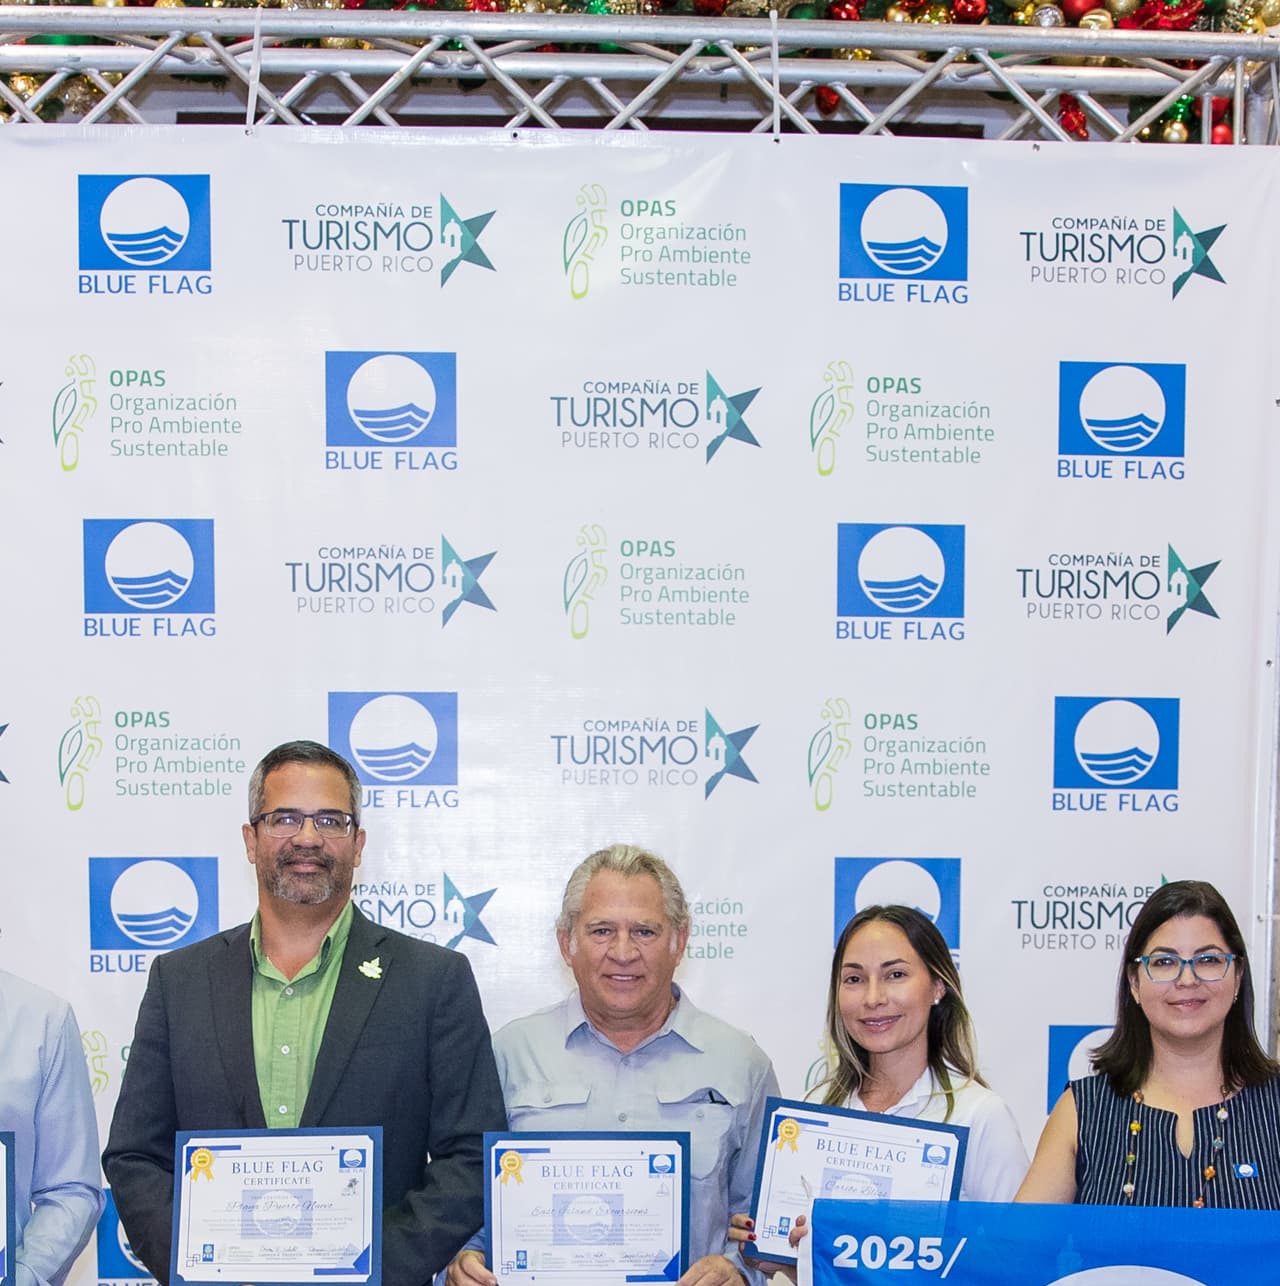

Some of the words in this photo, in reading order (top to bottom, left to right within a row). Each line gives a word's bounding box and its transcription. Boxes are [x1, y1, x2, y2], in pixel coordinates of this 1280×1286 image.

[315, 203, 405, 218] COMPAÑÍA
[411, 206, 432, 218] DE
[620, 199, 676, 217] OPAS
[1052, 216, 1139, 231] COMPAÑÍA
[1145, 219, 1166, 231] DE
[281, 219, 433, 252] TURISMO
[621, 222, 746, 245] Organización
[621, 245, 653, 262] Pro
[658, 245, 751, 264] Ambiente
[1019, 232, 1166, 264] TURISMO
[294, 254, 372, 271] PUERTO
[382, 255, 434, 273] RICO
[78, 275, 136, 294] BLUE
[149, 275, 212, 294] FLAG
[620, 268, 737, 287] Sustentable
[1031, 266, 1107, 283] PUERTO
[1116, 268, 1166, 285] RICO
[839, 283, 895, 302] BLUE
[907, 284, 968, 304] FLAG
[109, 370, 166, 387] OPAS
[583, 379, 671, 394] COMPAÑÍA
[677, 382, 699, 395] DE
[867, 376, 921, 394] OPAS
[110, 393, 237, 416] Organización
[550, 396, 699, 428] TURISMO
[866, 399, 990, 422] Organización
[111, 416, 143, 434] Pro
[149, 416, 242, 434] Ambiente
[867, 422, 898, 440] Pro
[903, 423, 995, 442] Ambiente
[110, 439, 228, 457] Sustentable
[562, 431, 639, 448] PUERTO
[649, 432, 699, 449] RICO
[325, 451, 382, 470] BLUE
[395, 451, 457, 470] FLAG
[866, 444, 981, 464] Sustentable
[1058, 459, 1112, 478] BLUE
[1125, 461, 1184, 480] FLAG
[318, 544, 407, 559] COMPAÑÍA
[413, 547, 434, 560] DE
[620, 540, 676, 558] OPAS
[1048, 552, 1134, 567] COMPAÑÍA
[1140, 555, 1160, 568] DE
[285, 562, 435, 593] TURISMO
[620, 562, 745, 585] Organización
[1016, 568, 1160, 600] TURISMO
[620, 585, 652, 603] Pro
[657, 585, 750, 604] Ambiente
[297, 597, 375, 613] PUERTO
[384, 597, 435, 614] RICO
[1027, 602, 1102, 619] PUERTO
[1112, 604, 1160, 620] RICO
[620, 607, 736, 626] Sustentable
[84, 618, 141, 637] BLUE
[153, 618, 216, 636] FLAG
[836, 621, 892, 640] BLUE
[904, 621, 964, 640] FLAG
[114, 711, 170, 728] OPAS
[583, 717, 671, 732] COMPAÑÍA
[677, 720, 698, 733] DE
[864, 713, 918, 730] OPAS
[115, 733, 241, 756] Organización
[550, 735, 698, 765] TURISMO
[863, 735, 986, 758] Organización
[116, 756, 148, 774] Pro
[153, 756, 246, 773] Ambiente
[864, 758, 895, 775] Pro
[900, 758, 991, 776] Ambiente
[115, 778, 232, 796] Sustentable
[562, 769, 639, 785] PUERTO
[648, 769, 698, 786] RICO
[397, 789, 459, 808] FLAG
[863, 780, 976, 798] Sustentable
[1053, 793, 1107, 811] BLUE
[1119, 793, 1178, 812] FLAG
[415, 884, 436, 896] DE
[1043, 883, 1128, 898] COMPAÑÍA
[1133, 886, 1154, 898] DE
[1022, 933, 1096, 950] PUERTO
[90, 954, 146, 973] BLUE
[816, 1138, 858, 1156] BLUE
[865, 1146, 907, 1163] FLAG
[232, 1161, 274, 1174] BLUE
[282, 1160, 323, 1173] FLAG
[541, 1165, 584, 1178] BLUE
[592, 1165, 633, 1177] FLAG
[826, 1157, 892, 1173] CERTIFICATE
[244, 1177, 311, 1186] CERTIFICATE
[553, 1182, 621, 1190] CERTIFICATE
[832, 1234, 968, 1279] 2025/
